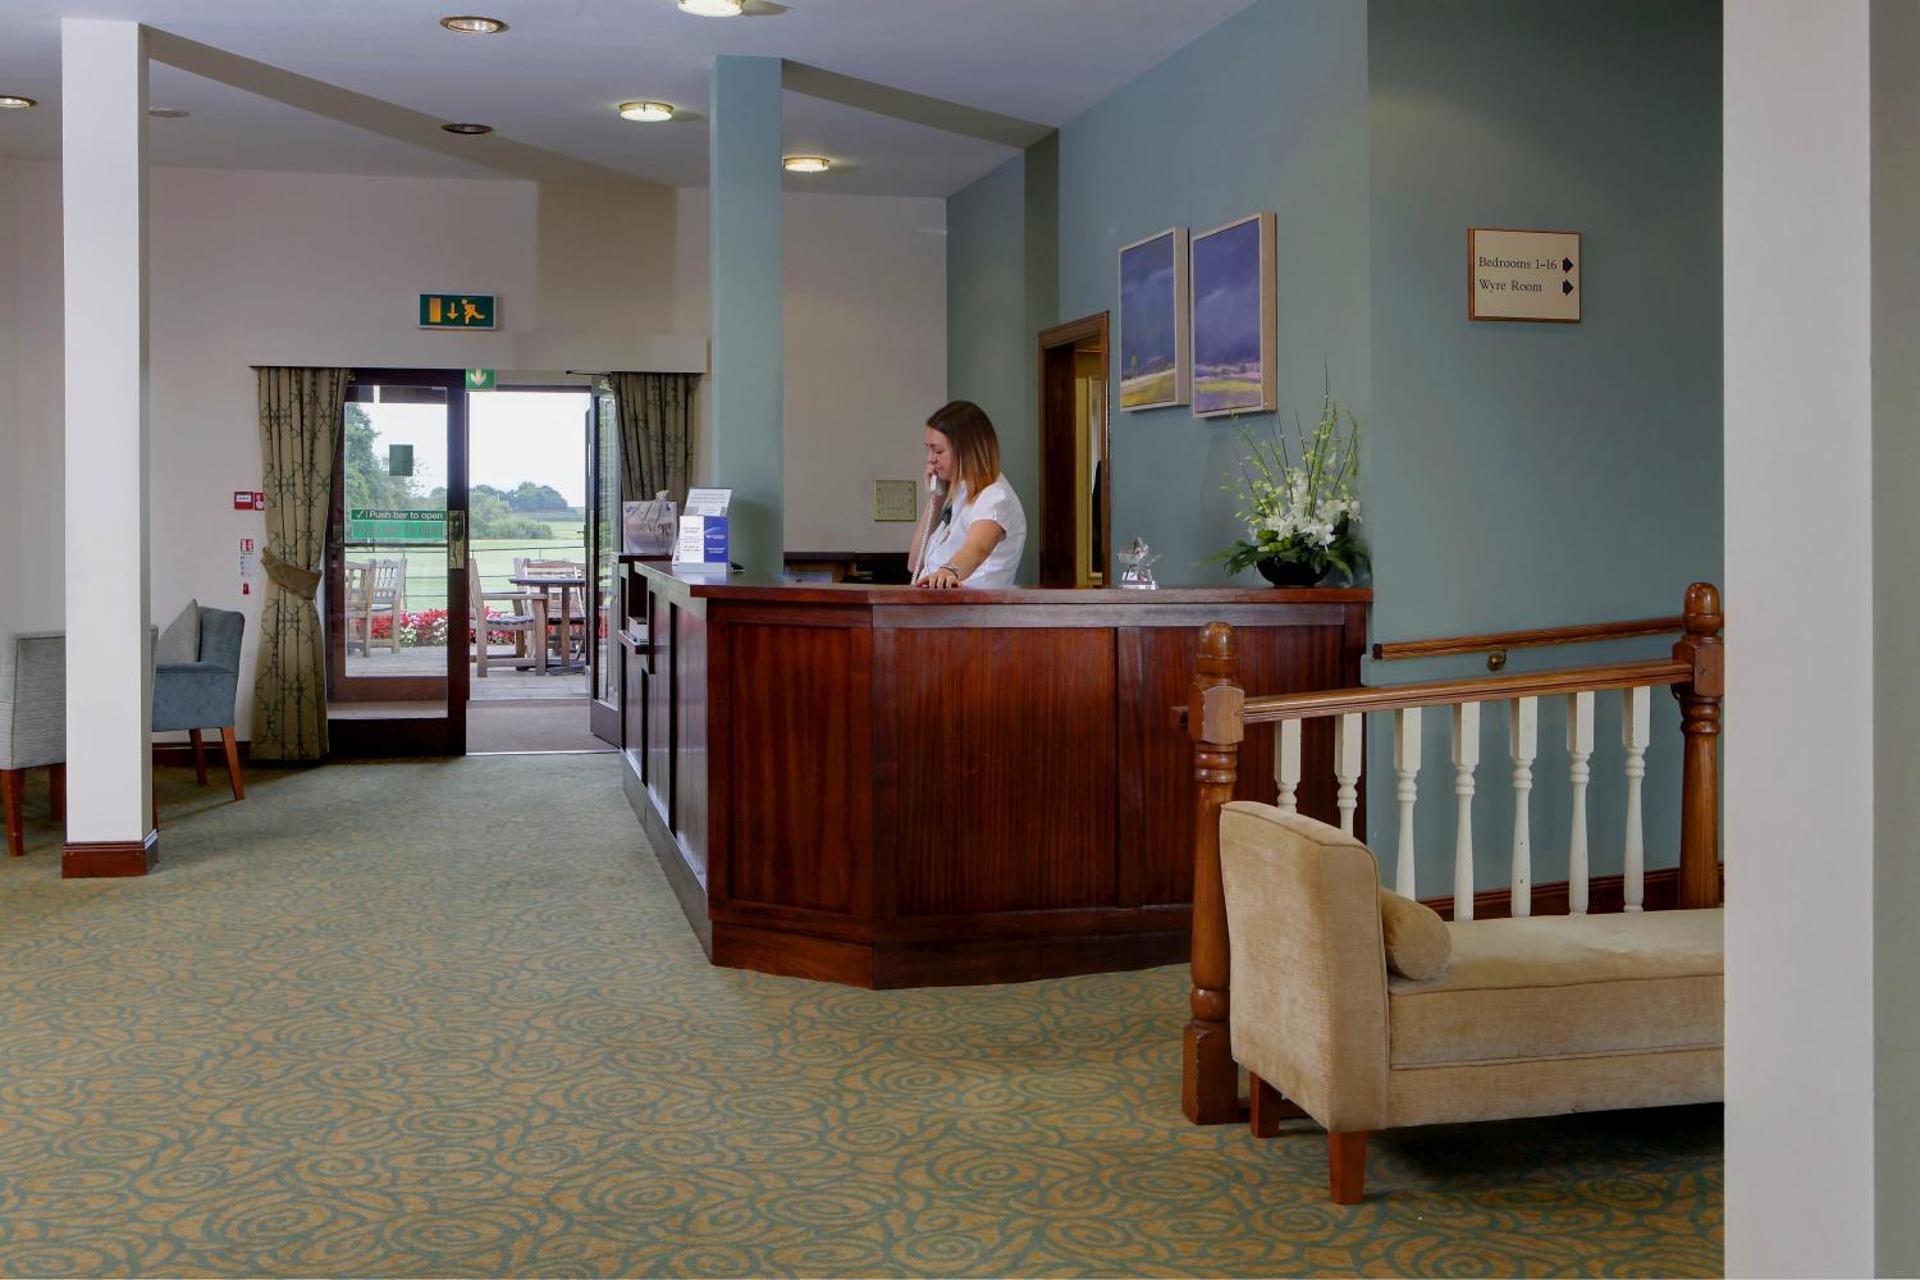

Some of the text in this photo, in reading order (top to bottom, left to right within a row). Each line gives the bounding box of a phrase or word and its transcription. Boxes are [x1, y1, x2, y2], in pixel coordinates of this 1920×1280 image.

[1479, 256, 1531, 269] Bedrooms
[1479, 279, 1542, 293] Wyre Room
[369, 511, 443, 521] Push bar to open
